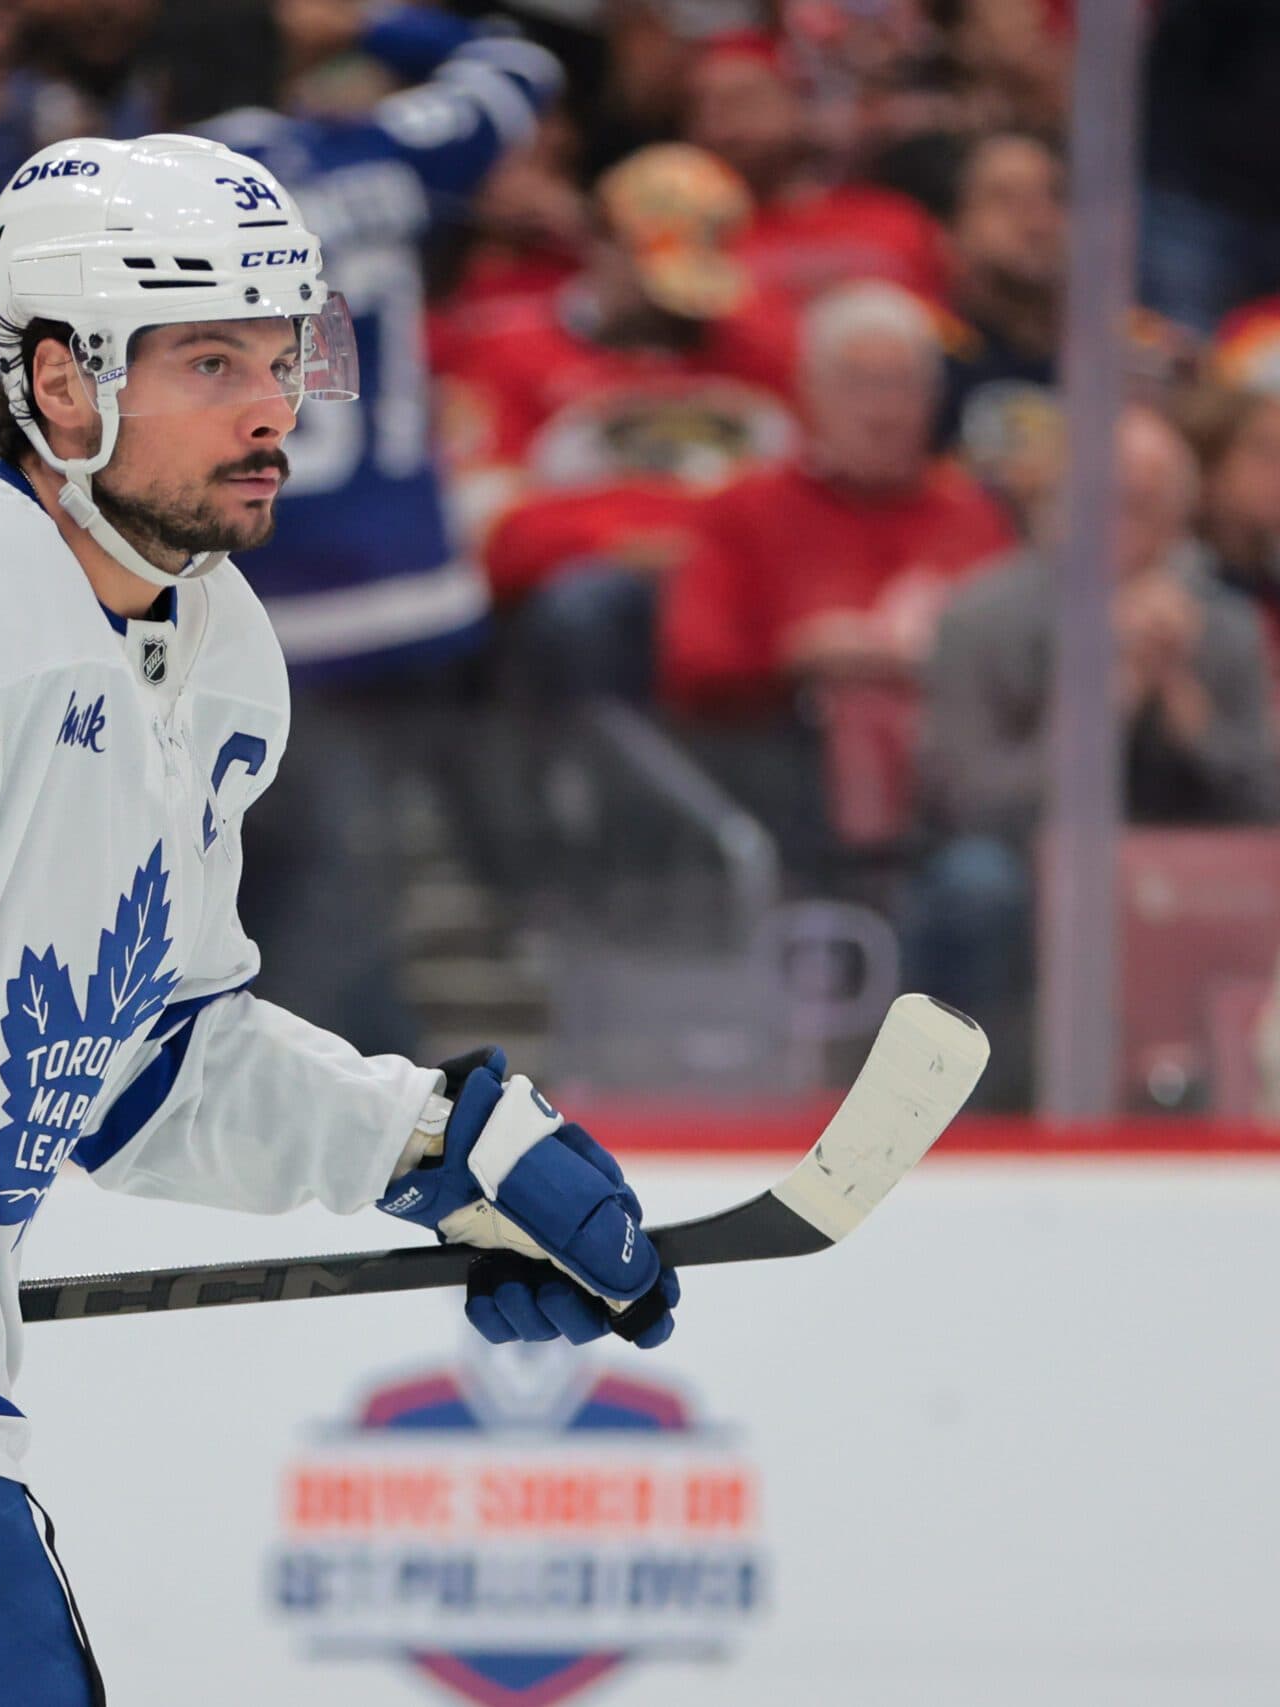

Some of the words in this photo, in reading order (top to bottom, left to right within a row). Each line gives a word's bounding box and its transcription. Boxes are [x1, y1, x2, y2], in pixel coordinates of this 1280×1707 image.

[12, 159, 100, 190] OREO
[215, 176, 281, 210] 34
[240, 248, 309, 268] CCM
[144, 650, 164, 676] NHL
